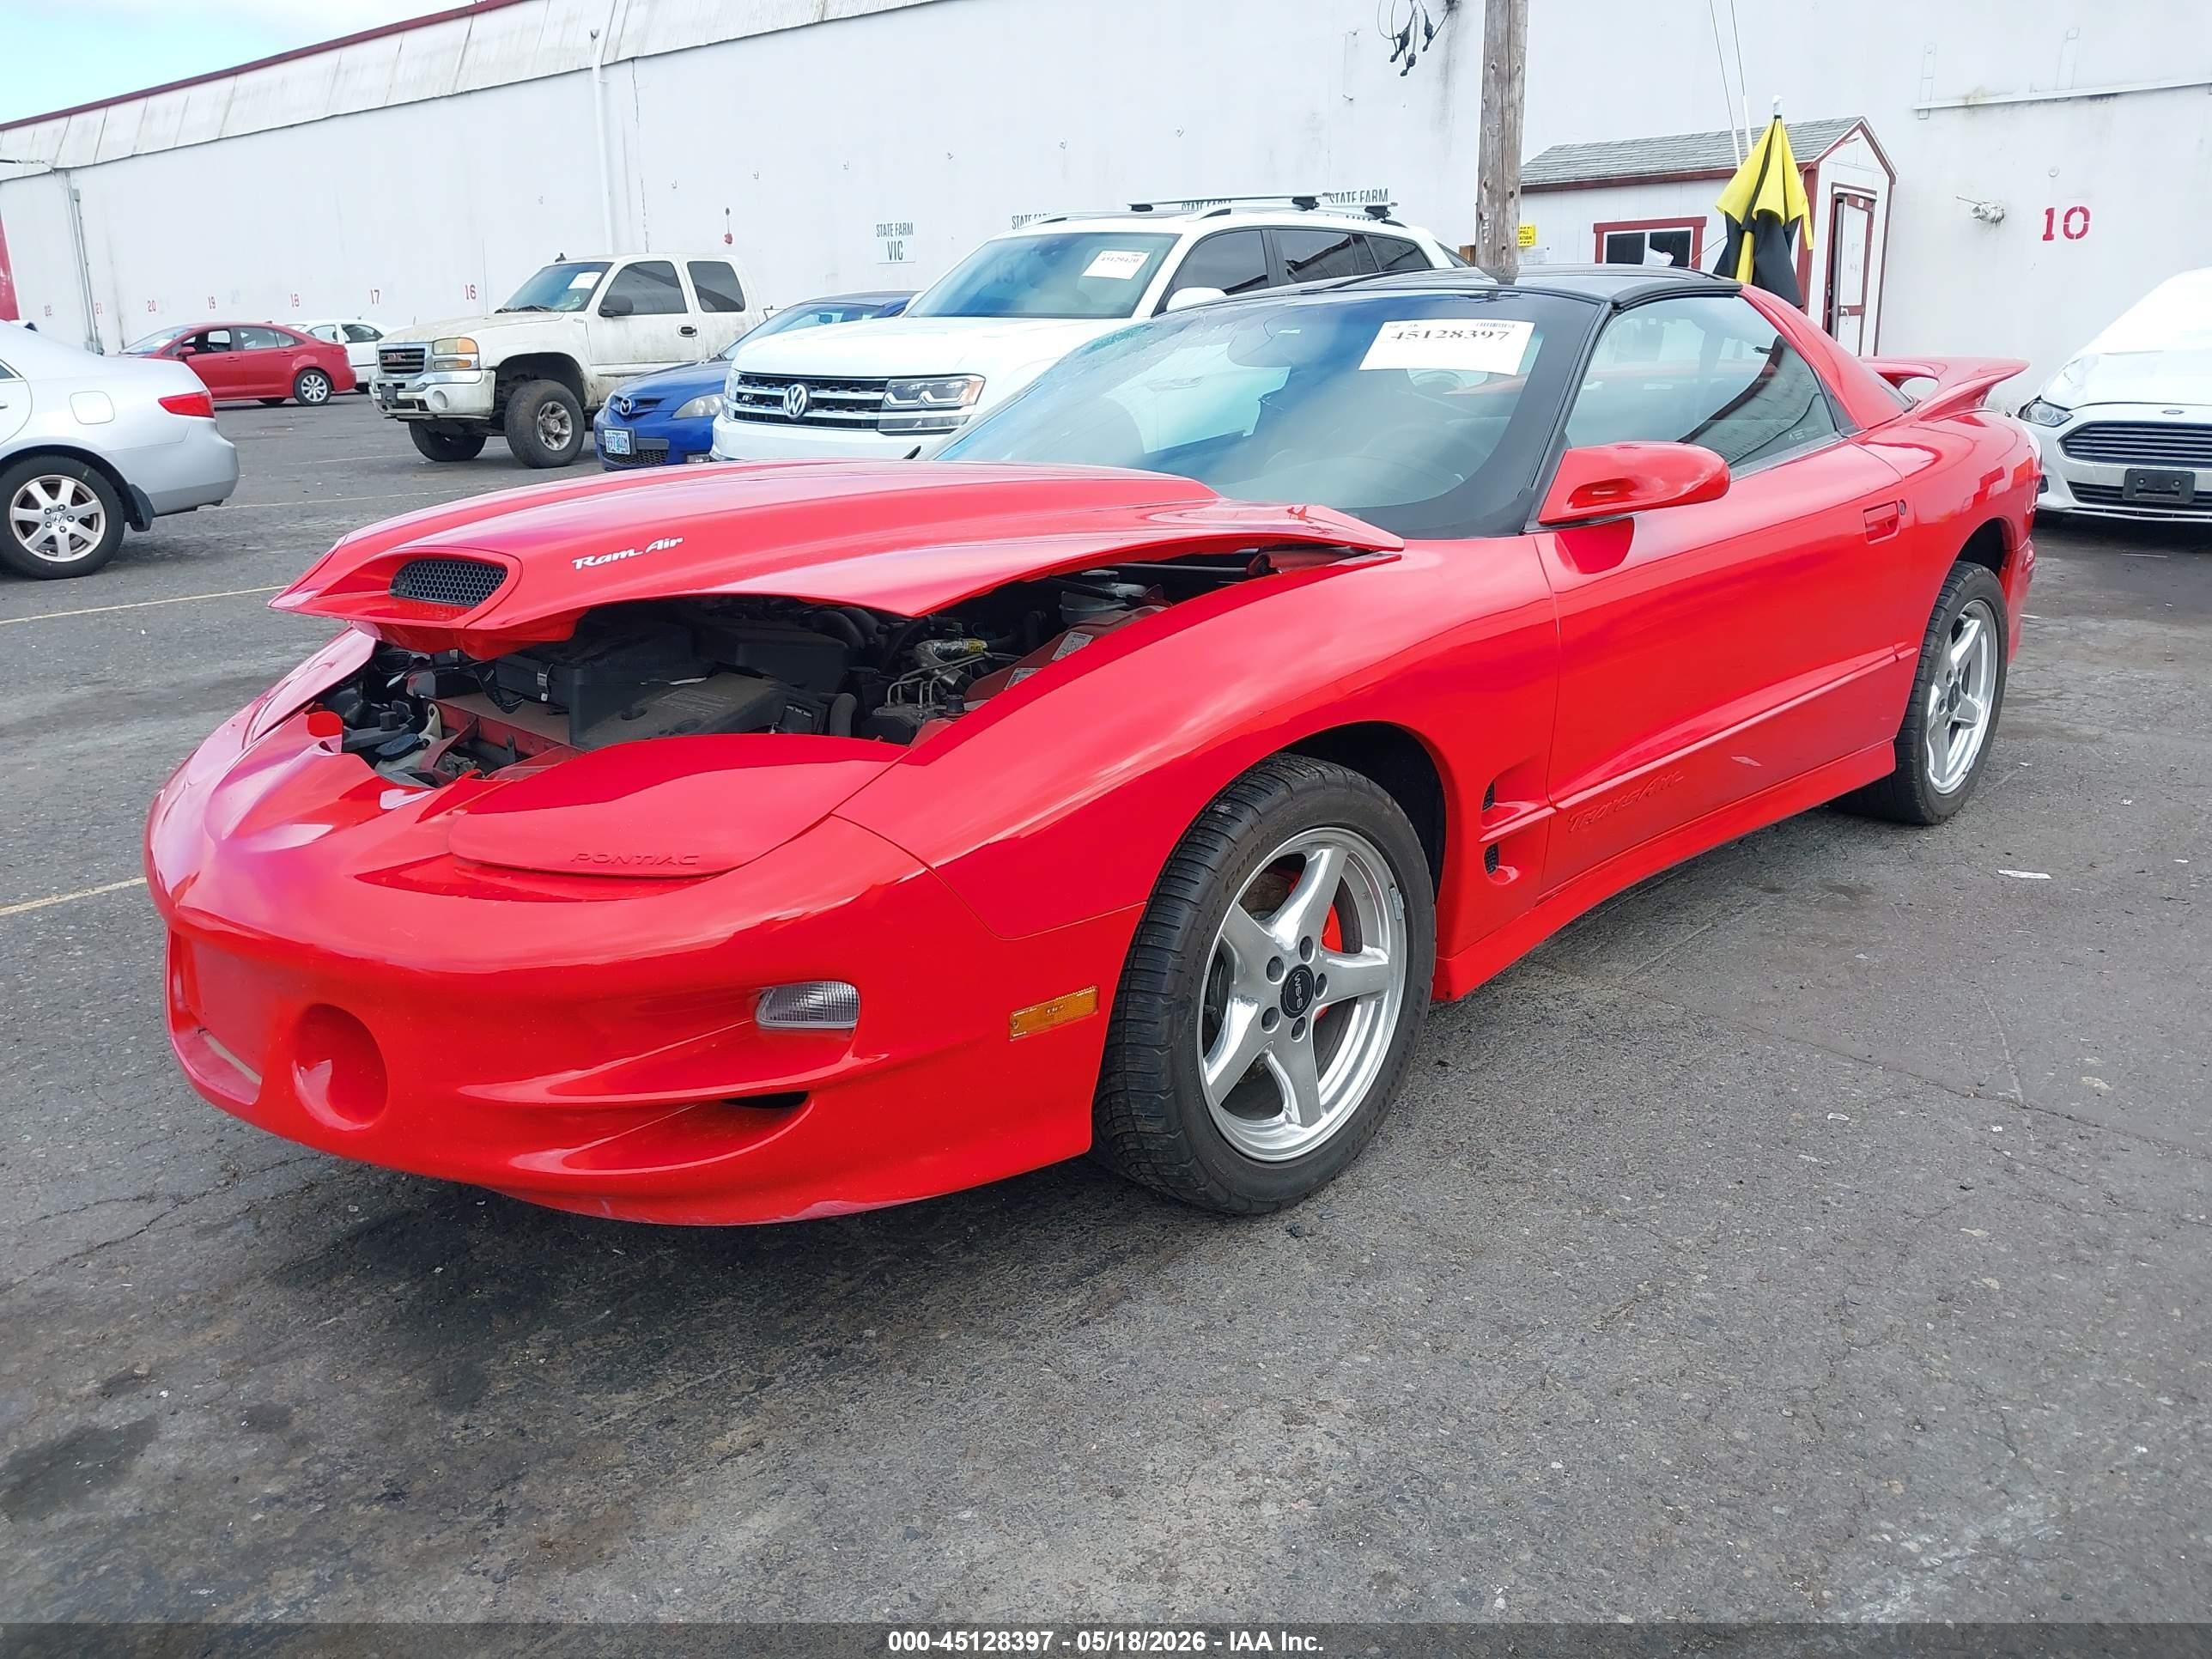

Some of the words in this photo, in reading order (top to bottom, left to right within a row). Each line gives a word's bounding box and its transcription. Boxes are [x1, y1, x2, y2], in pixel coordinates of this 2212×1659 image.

[1359, 188, 1389, 203] FARM
[876, 222, 894, 238] STATE
[895, 222, 914, 237] FARM
[2043, 206, 2090, 240] 10
[887, 240, 903, 261] VIC
[290, 293, 301, 307] 18
[370, 289, 380, 304] 17
[465, 284, 477, 301] 16
[147, 300, 157, 313] 20
[208, 295, 216, 310] 19
[1390, 330, 1511, 340] 45128397
[572, 548, 643, 570] Ram
[645, 537, 684, 554] Air
[571, 853, 700, 866] PONTIAC
